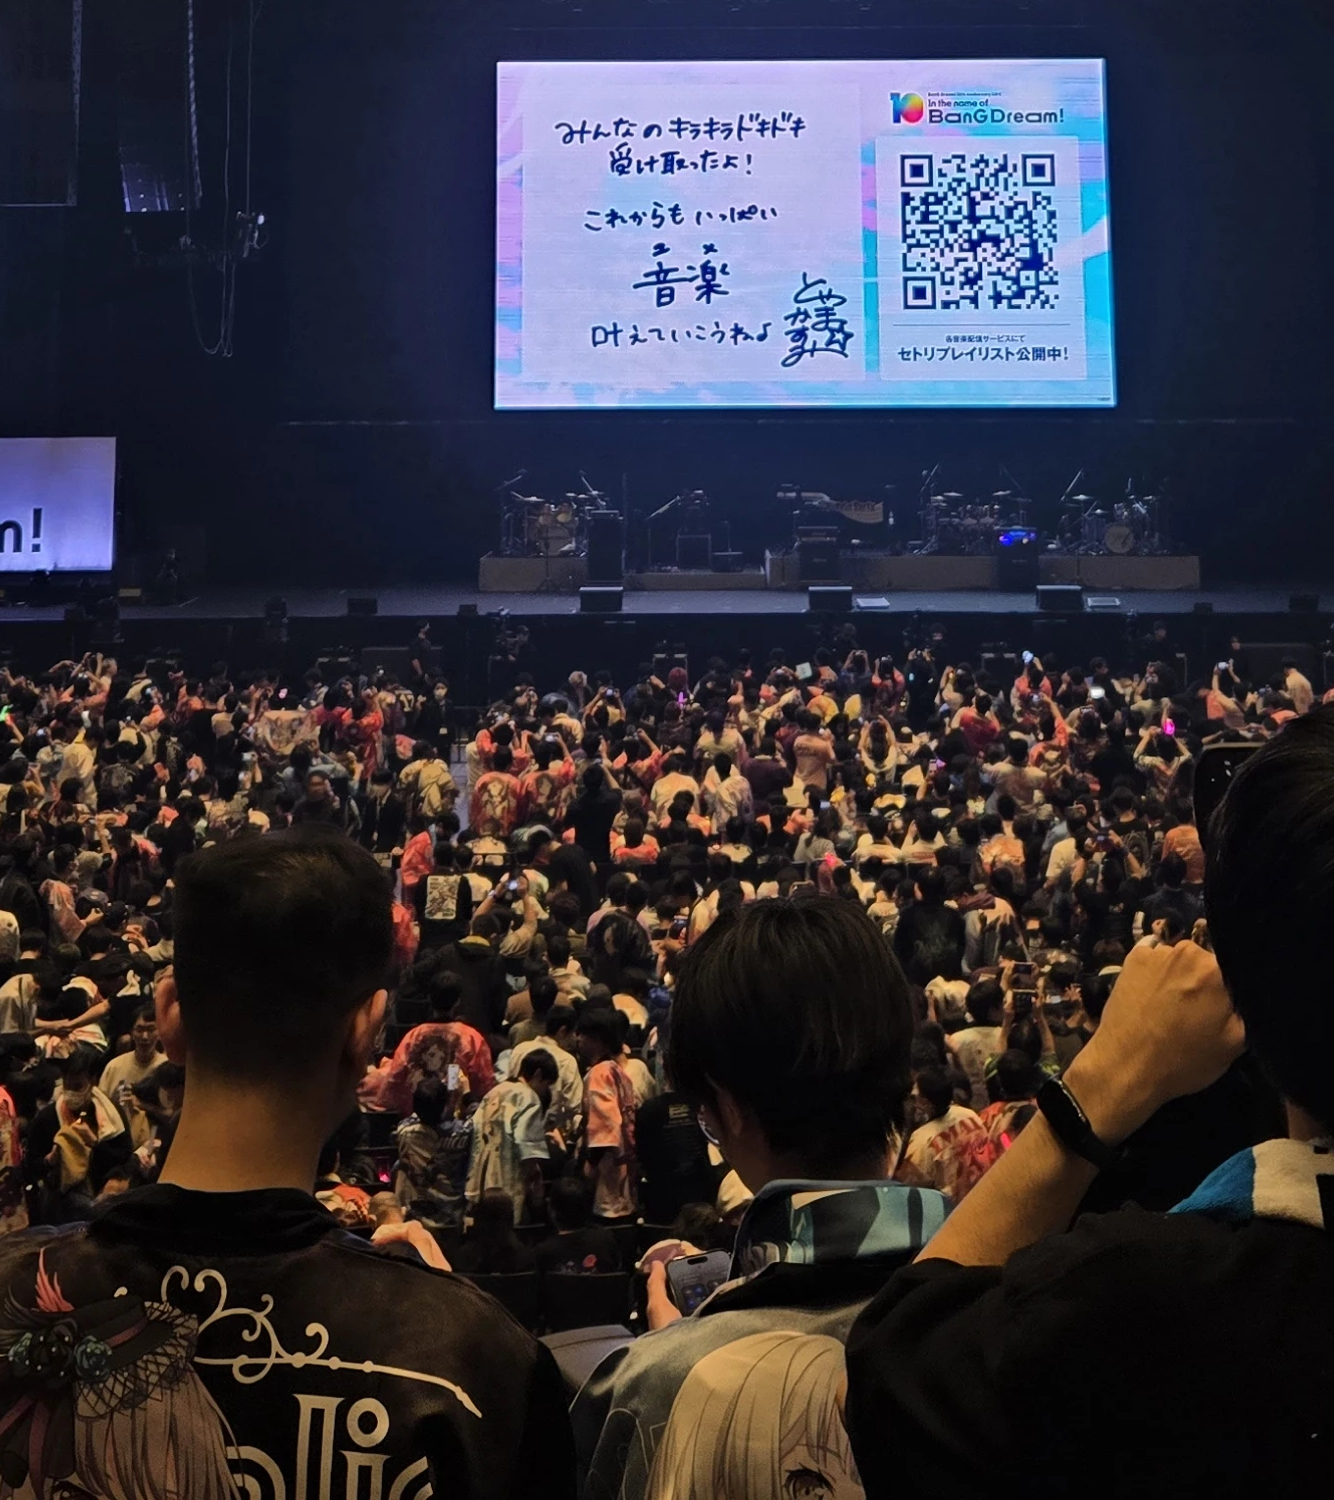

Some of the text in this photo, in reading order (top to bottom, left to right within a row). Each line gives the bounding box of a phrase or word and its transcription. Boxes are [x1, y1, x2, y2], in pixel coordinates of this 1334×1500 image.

[938, 99, 952, 107] the
[979, 99, 989, 107] of
[632, 259, 731, 308] 音楽
